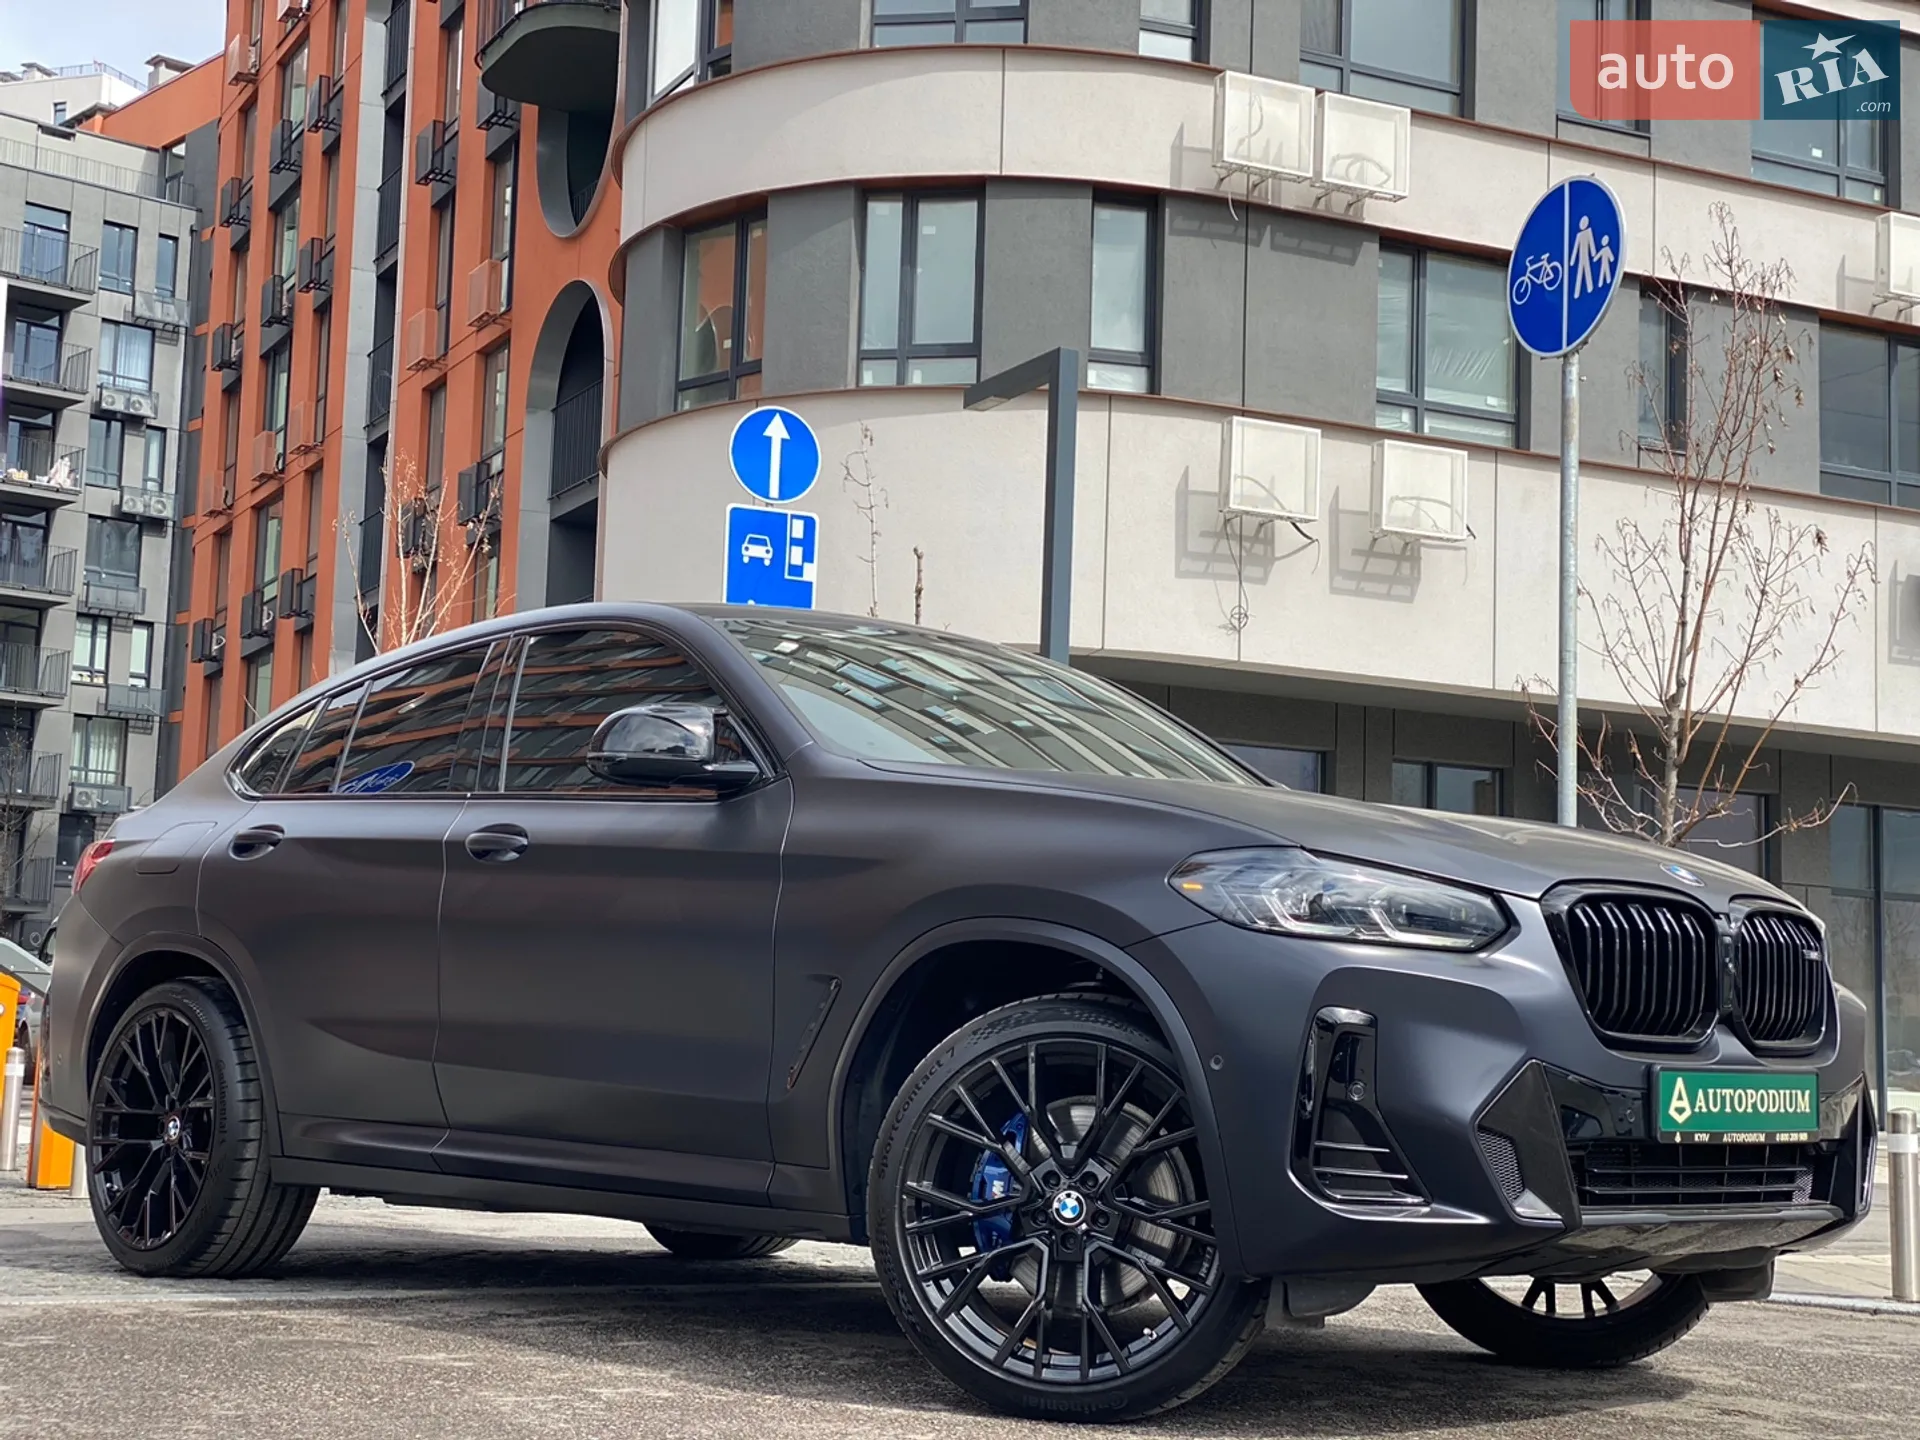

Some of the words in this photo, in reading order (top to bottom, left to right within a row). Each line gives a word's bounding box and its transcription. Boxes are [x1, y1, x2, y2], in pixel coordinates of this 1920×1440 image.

[945, 1045, 956, 1059] 7
[1694, 1088, 1811, 1113] AUTOPODIUM
[1722, 1132, 1766, 1143] AUTOPODIUM
